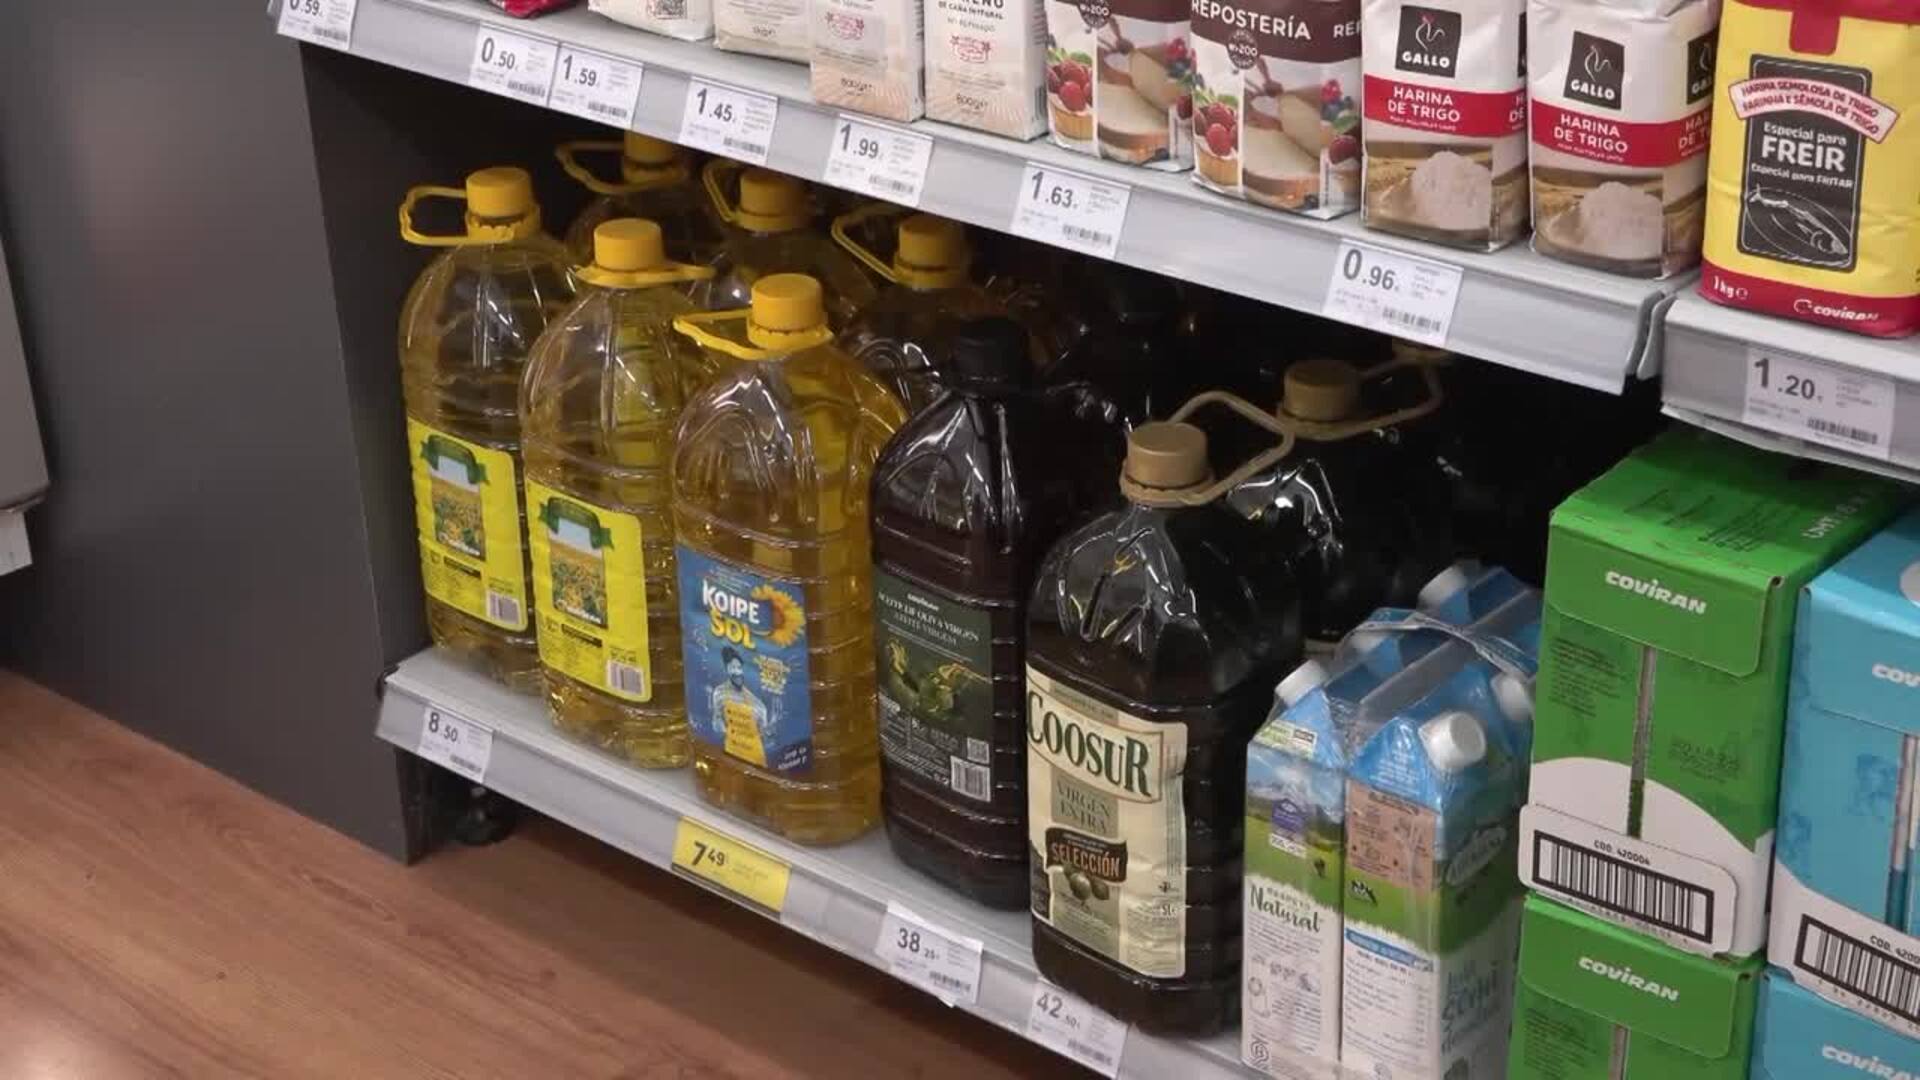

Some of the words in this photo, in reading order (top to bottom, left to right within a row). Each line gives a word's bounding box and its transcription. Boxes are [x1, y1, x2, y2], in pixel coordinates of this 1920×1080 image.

[1402, 51, 1450, 68] GALLO
[1393, 85, 1453, 106] HARINA
[1571, 79, 1615, 100] GALLO
[1388, 99, 1406, 115] DE
[1411, 104, 1461, 122] TRIGO
[1833, 90, 1845, 101] DE
[1847, 97, 1879, 118] TRIGO
[1561, 114, 1620, 138] HARINA
[1764, 121, 1813, 141] Especial
[1817, 133, 1847, 146] para
[1835, 105, 1848, 117] DE
[1850, 113, 1879, 134] TRIGO
[1554, 127, 1573, 142] DE
[1578, 133, 1628, 153] TRIGO
[1762, 135, 1845, 172] FREIR
[1751, 163, 1790, 178] Especial
[1791, 172, 1815, 183] para
[1816, 175, 1853, 188] FRITAR
[703, 579, 760, 624] KOIPE
[710, 607, 756, 649] SOL
[1028, 690, 1152, 797] COOSUR
[1057, 780, 1110, 818] VIRGEN
[1060, 801, 1107, 834] EXTRA
[1051, 842, 1120, 877] SELECCIÓN
[1617, 848, 1651, 865] 420004
[1250, 884, 1321, 933] Natural
